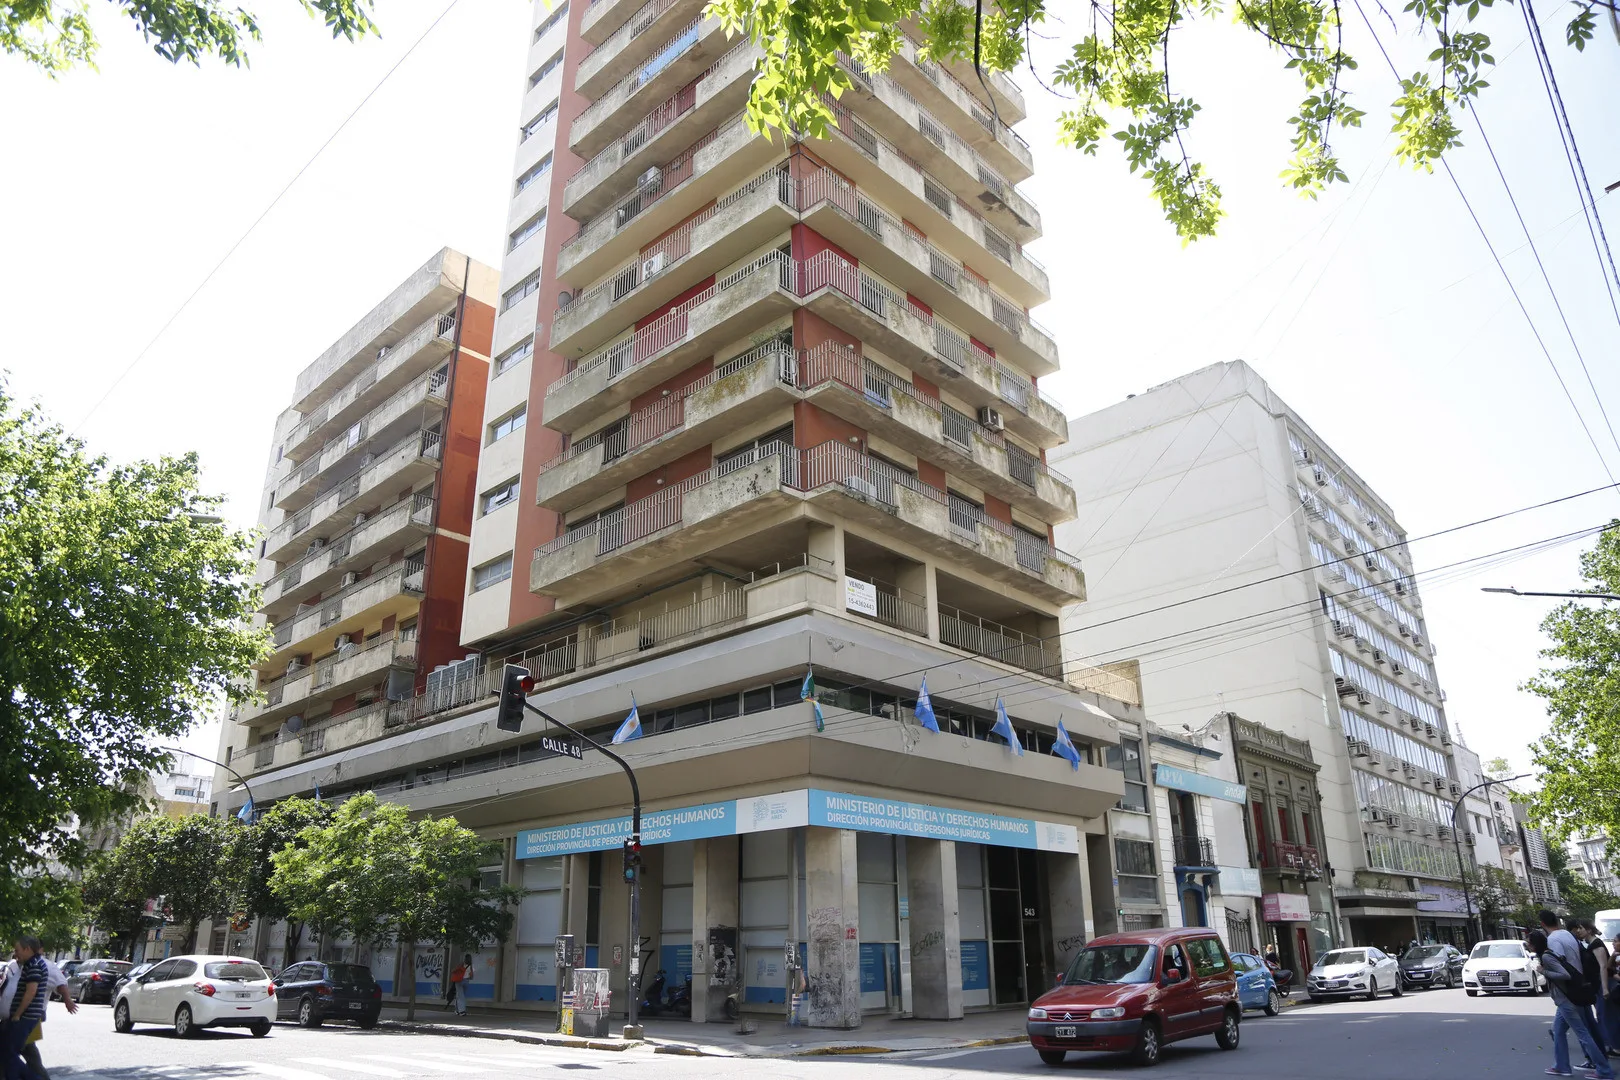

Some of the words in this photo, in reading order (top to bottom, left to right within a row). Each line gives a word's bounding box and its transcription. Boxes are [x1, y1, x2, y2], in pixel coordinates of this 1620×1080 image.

[848, 580, 865, 591] VENDO
[542, 737, 568, 755] CALLE
[571, 745, 581, 758] 48
[527, 829, 570, 844] MINISTERIO
[570, 828, 582, 839] DE
[581, 823, 616, 839] JUSTICIA
[617, 821, 624, 833] Y
[624, 814, 672, 832] DECHOS
[673, 807, 725, 825] HUMANOS
[826, 796, 885, 815] MINISTERIO
[887, 804, 900, 817] DE
[901, 806, 938, 820] JUSTICIA
[939, 812, 945, 823] Y
[946, 813, 989, 829] DERECHOS
[990, 819, 1029, 834] HUMANOS
[827, 812, 868, 826] DIRECCIÓN
[870, 818, 913, 831] PROVINCIAL
[914, 822, 924, 832] DE
[924, 824, 959, 837] PERSONAS
[959, 828, 991, 840] JURÍDICAS
[526, 842, 556, 854] DIRECCIÓN
[556, 838, 591, 851] PROVINCIAL
[592, 837, 601, 847] DE
[639, 829, 671, 841] URÍDICAS
[1024, 908, 1036, 917] 543
